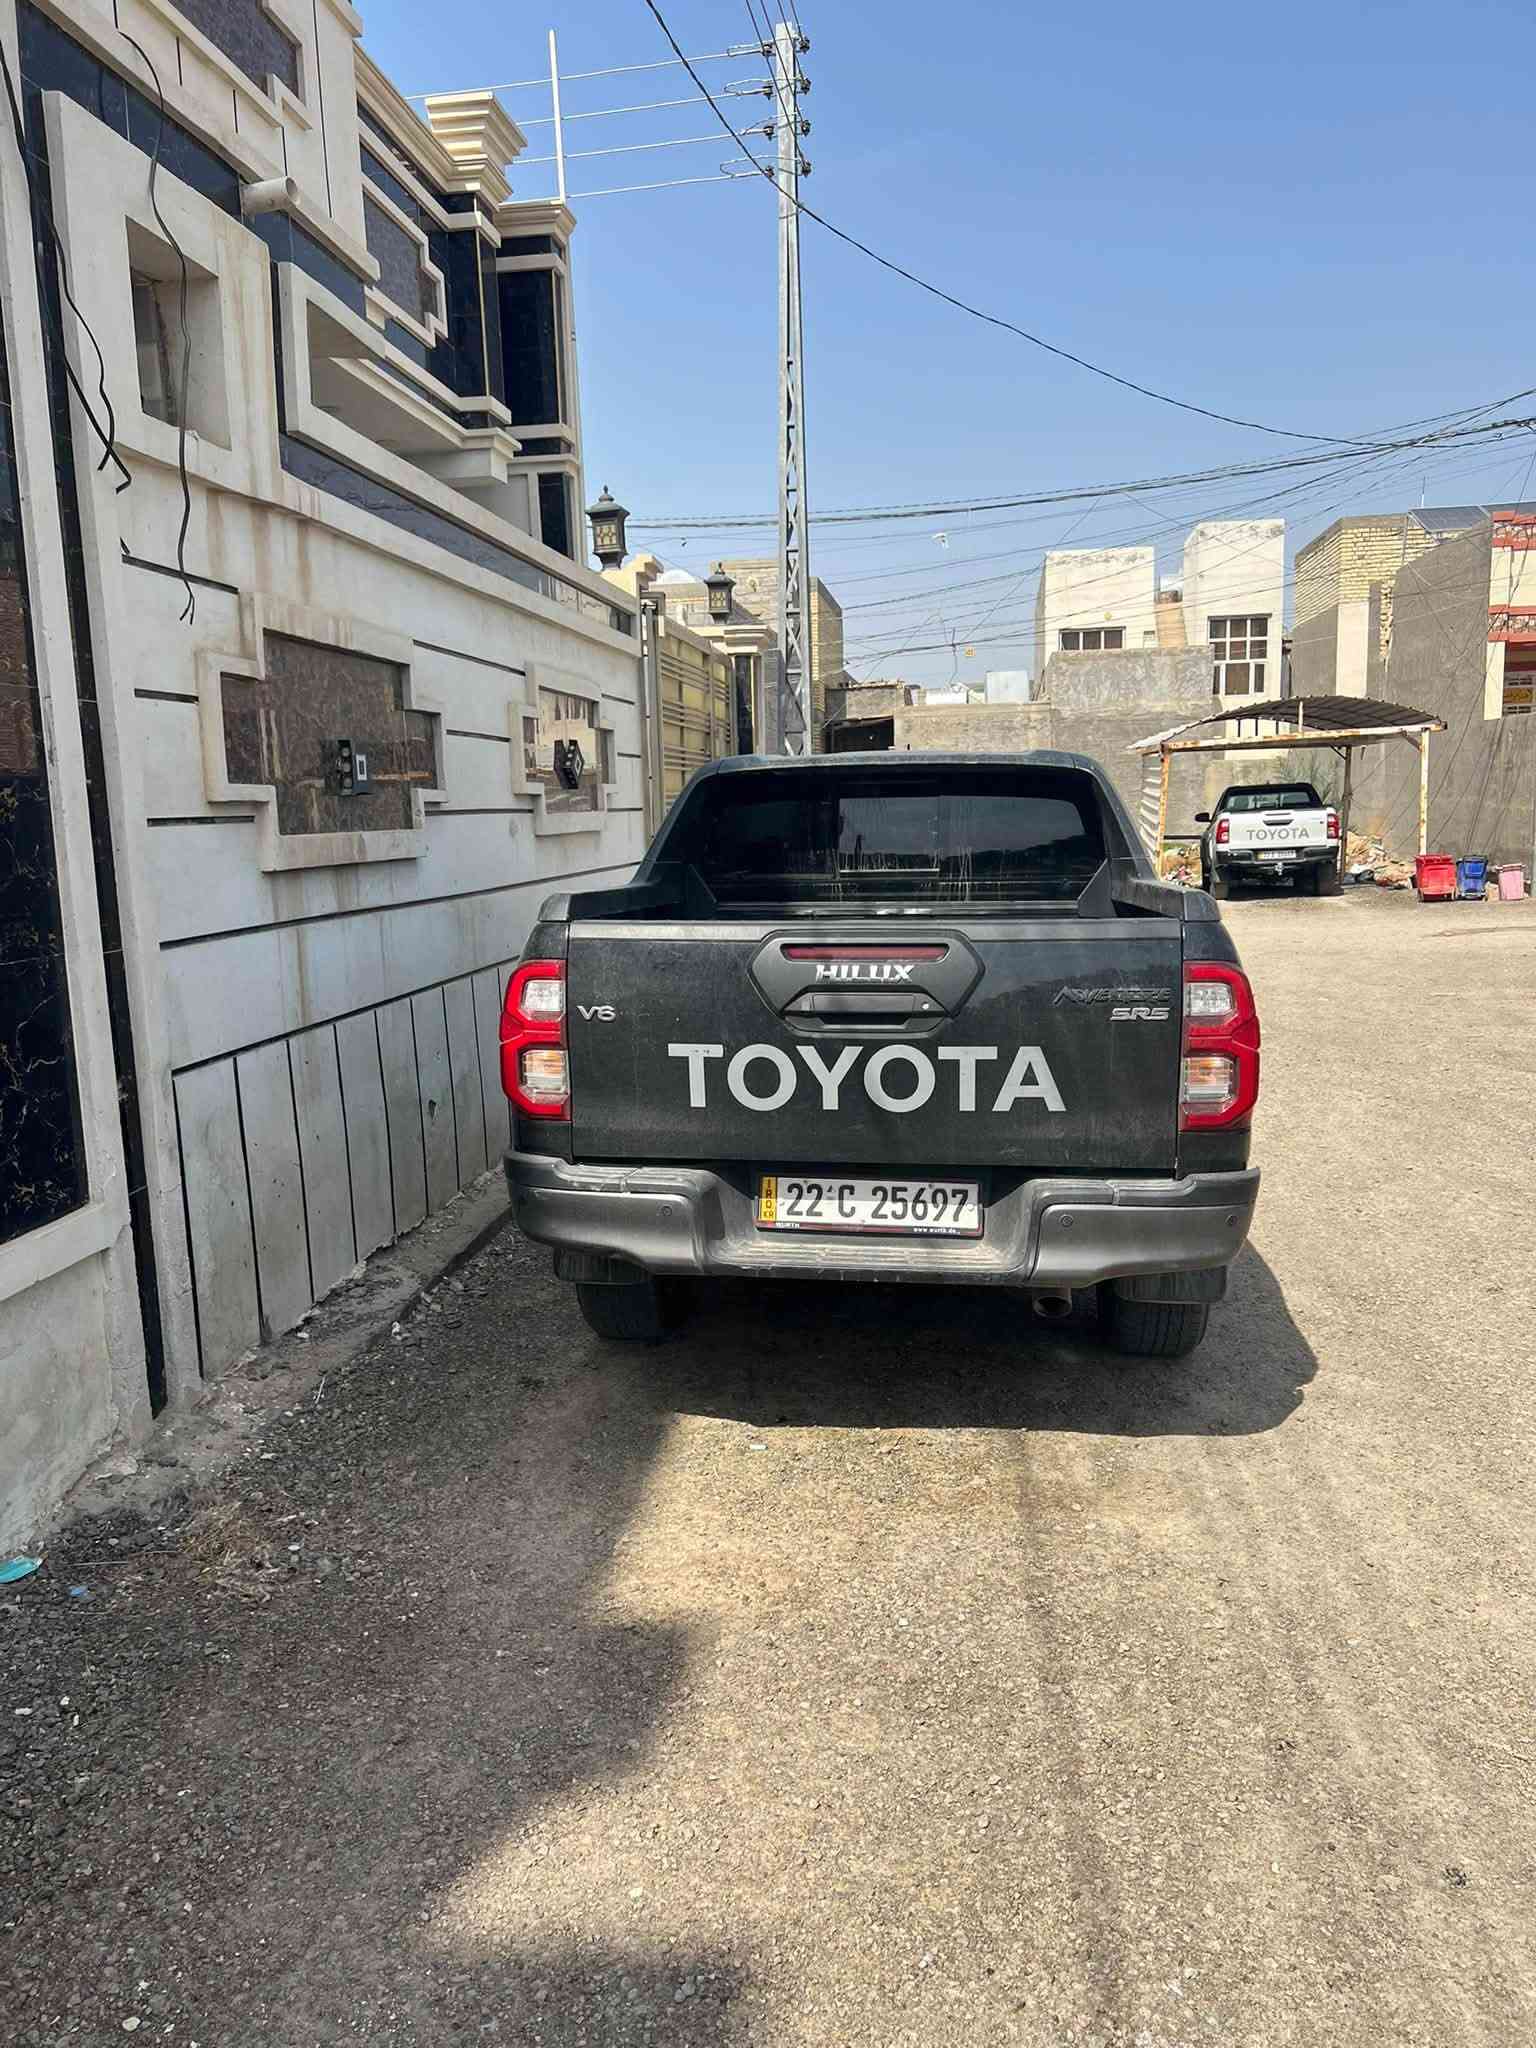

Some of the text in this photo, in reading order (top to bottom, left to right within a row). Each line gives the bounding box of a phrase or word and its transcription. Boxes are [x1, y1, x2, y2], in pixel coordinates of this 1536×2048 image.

[1246, 828, 1310, 840] TOYOTA
[815, 964, 914, 984] HILUX
[576, 1005, 616, 1022] V6
[667, 1043, 1066, 1113] TOYOTA
[786, 1183, 969, 1222] 22 C 25697
